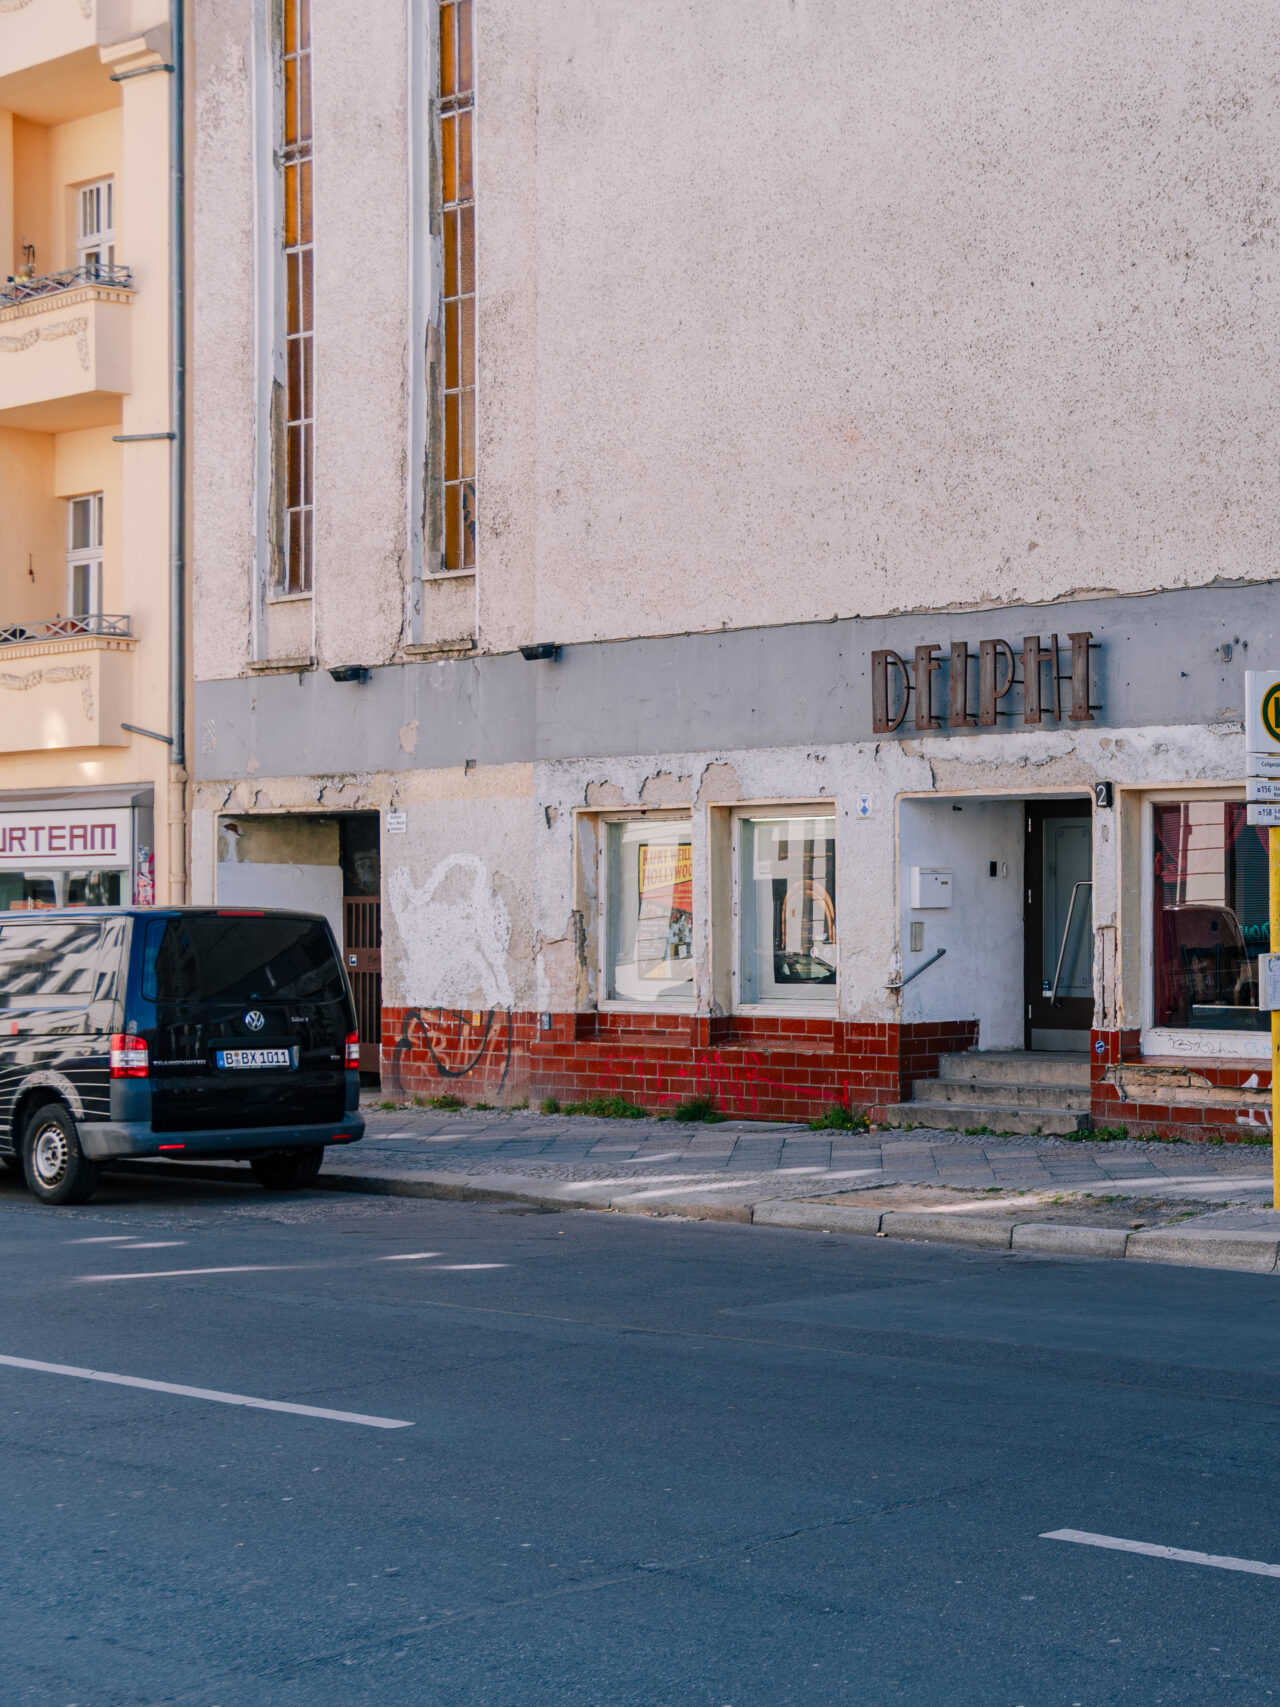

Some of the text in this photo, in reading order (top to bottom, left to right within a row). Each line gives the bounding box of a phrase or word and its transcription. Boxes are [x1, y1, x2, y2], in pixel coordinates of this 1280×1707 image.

[871, 632, 1095, 734] DELPHI
[1097, 784, 1107, 806] 2
[1261, 785, 1272, 793] 156
[1262, 808, 1273, 817] 158
[225, 1051, 288, 1065] B BX 1011
